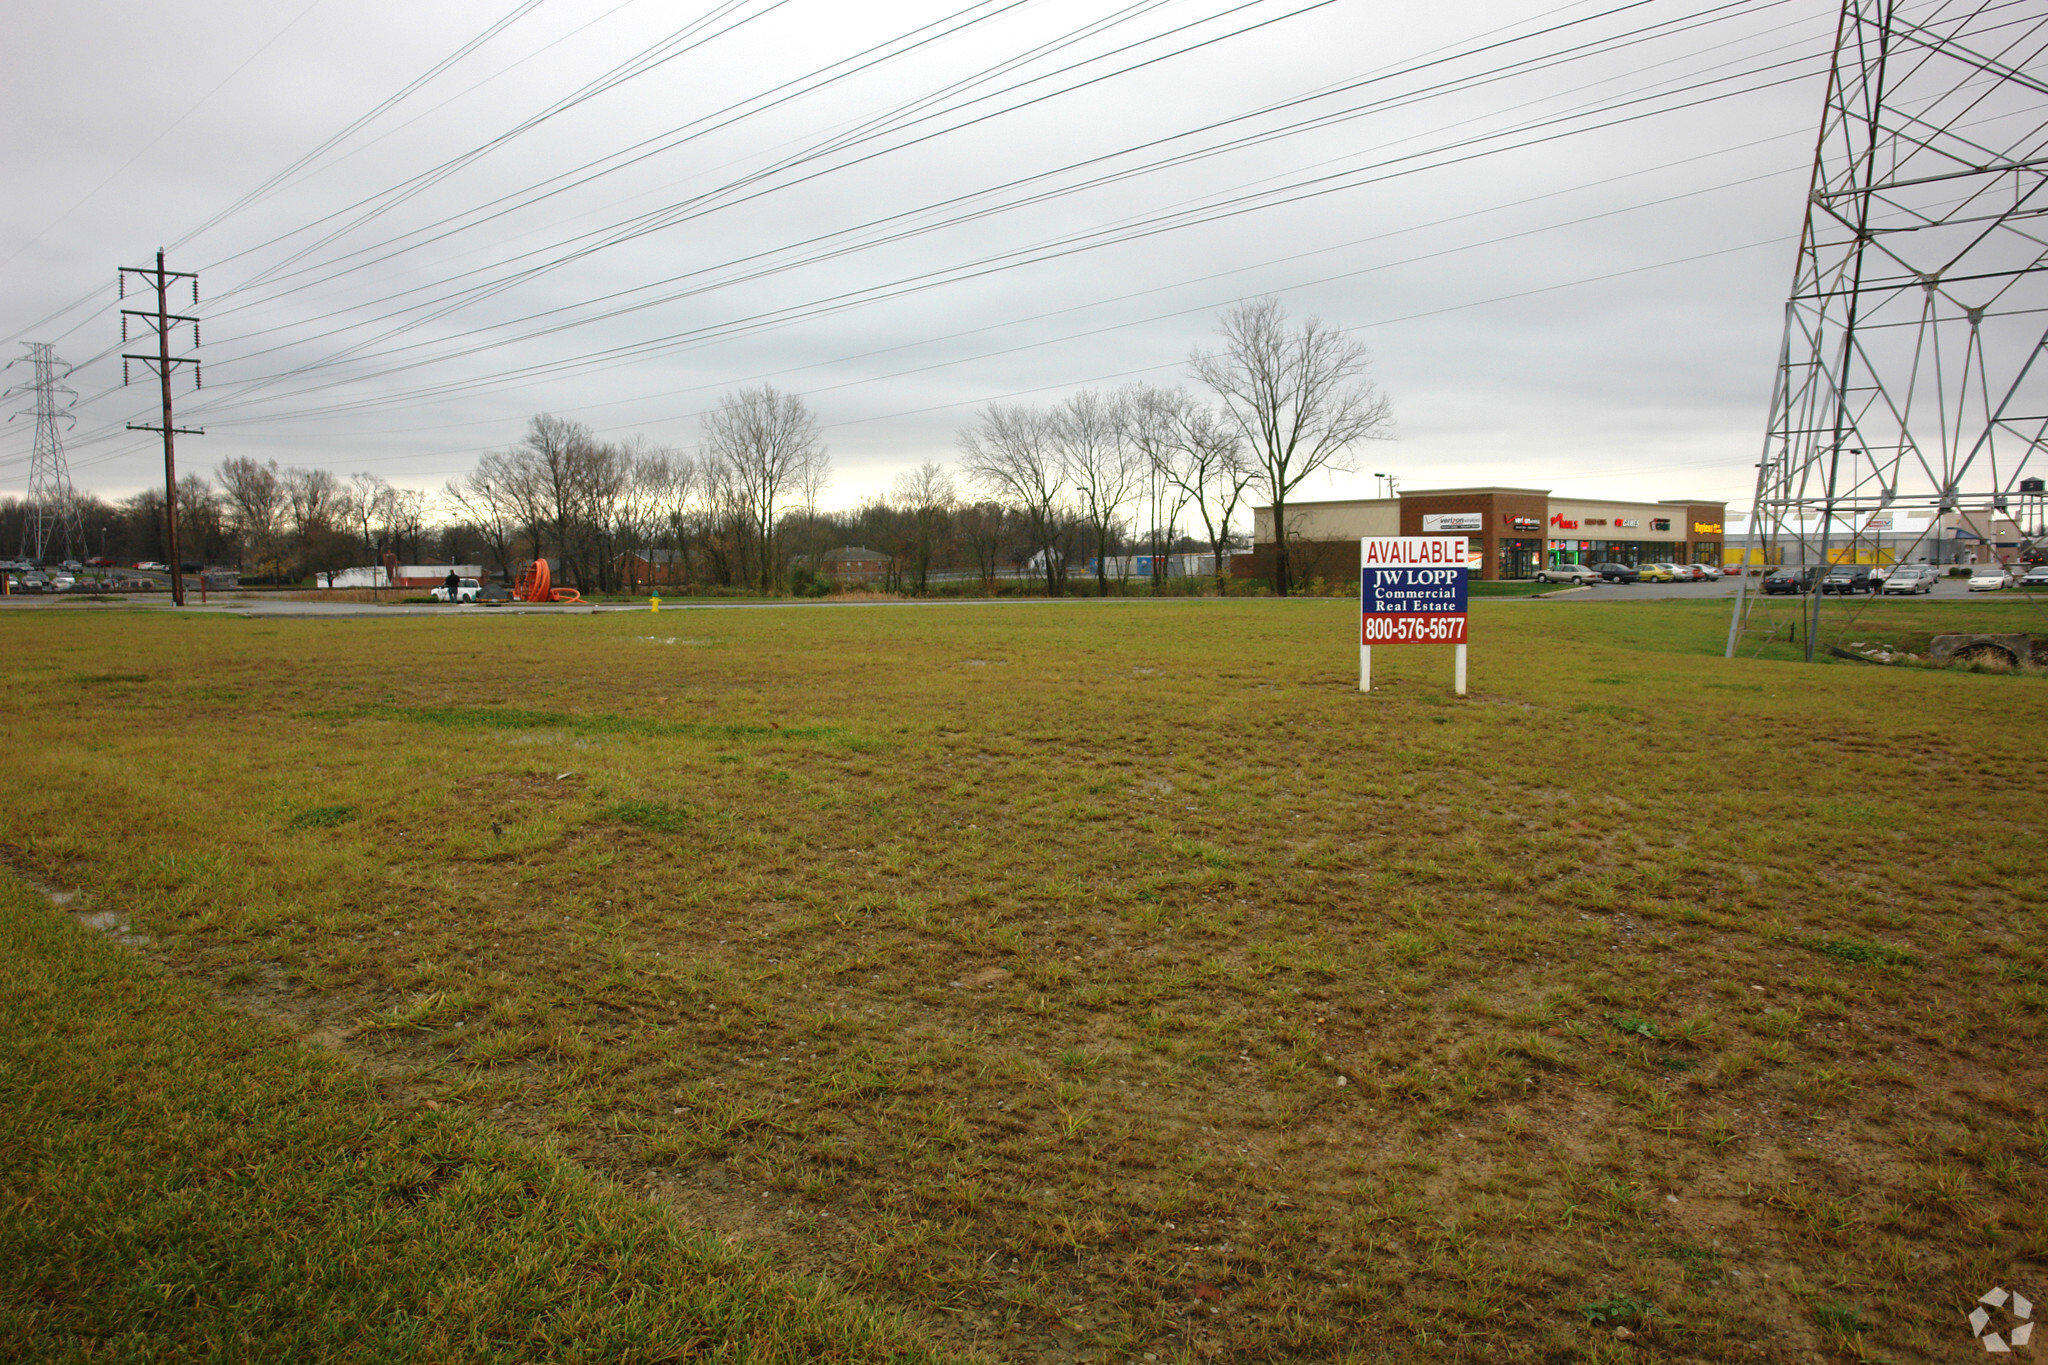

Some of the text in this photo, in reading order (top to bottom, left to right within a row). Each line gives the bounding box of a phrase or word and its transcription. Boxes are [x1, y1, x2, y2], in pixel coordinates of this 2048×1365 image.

[1366, 541, 1465, 564] AVAILABLE
[1373, 570, 1458, 588] JW LOPP
[1374, 587, 1456, 599] Commercial
[1375, 600, 1456, 611] Real Estate
[1365, 617, 1465, 640] 800-576-5677
